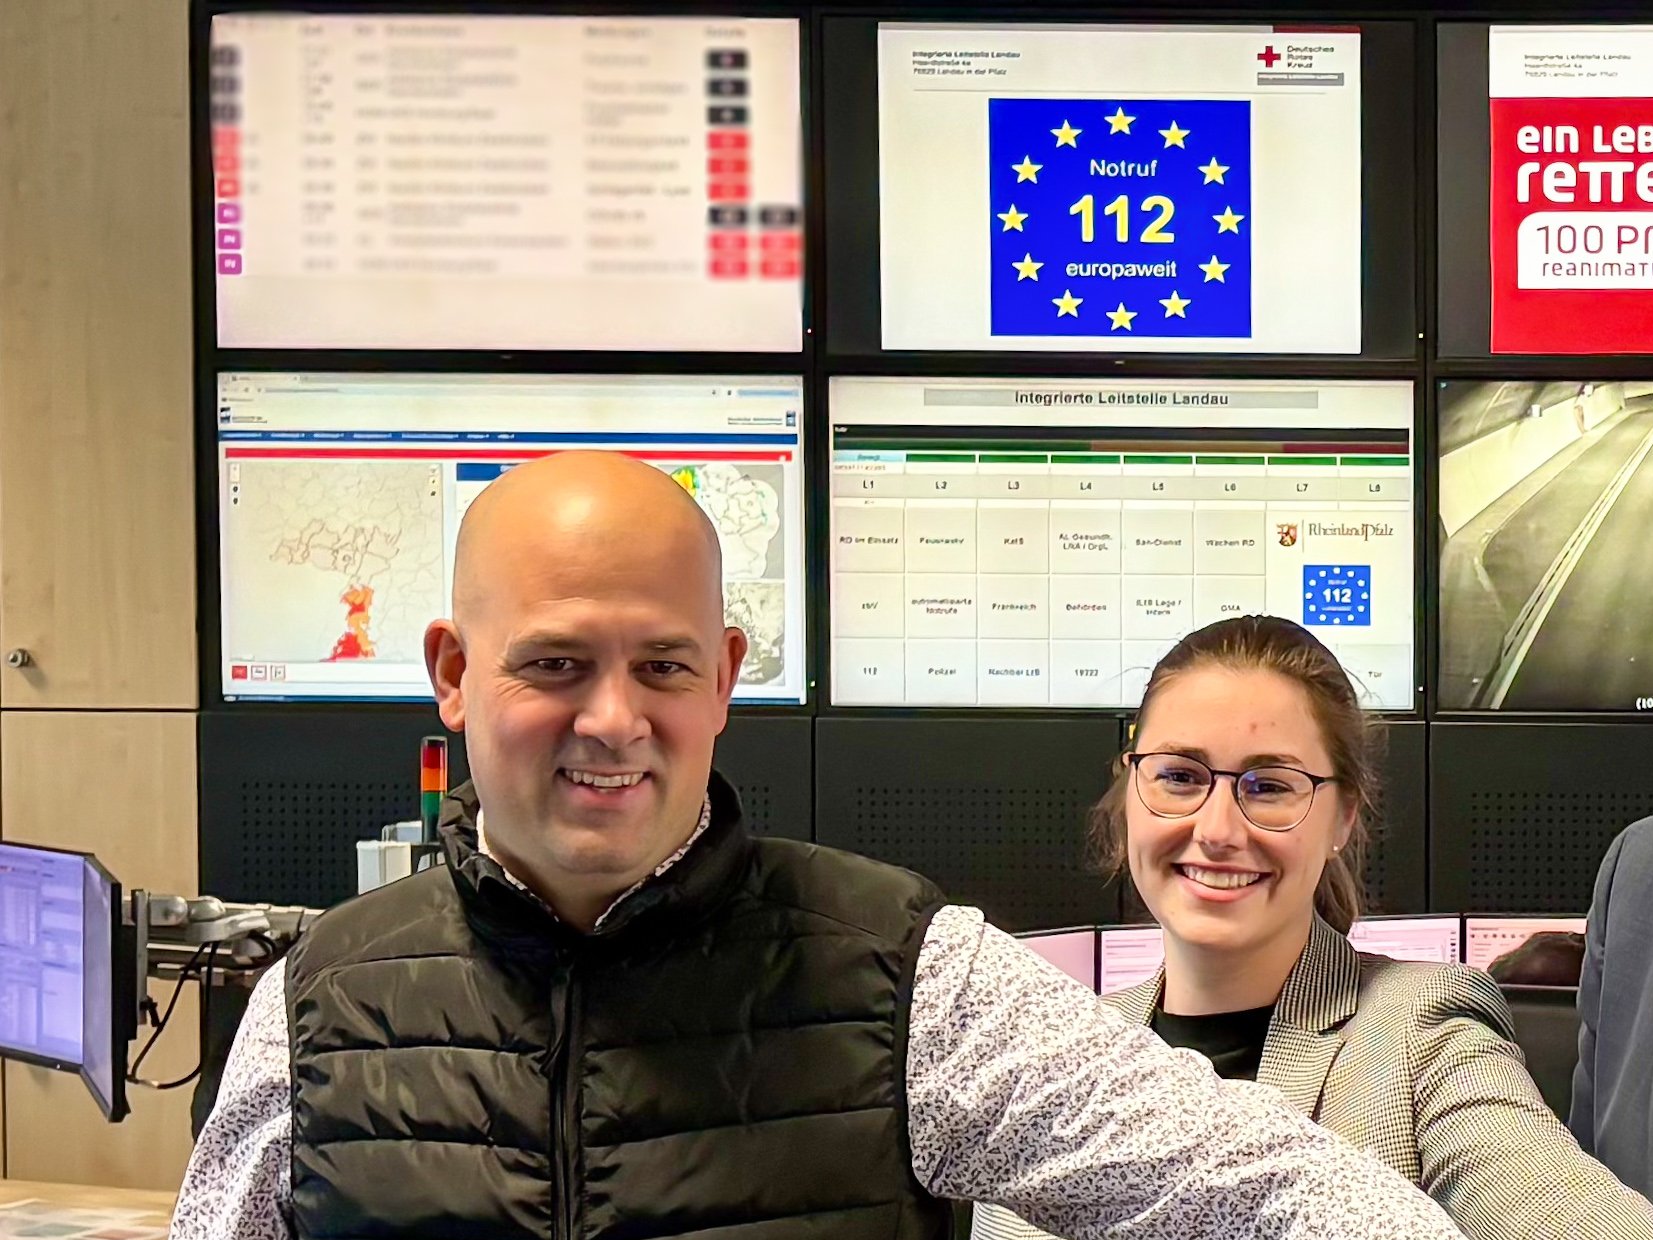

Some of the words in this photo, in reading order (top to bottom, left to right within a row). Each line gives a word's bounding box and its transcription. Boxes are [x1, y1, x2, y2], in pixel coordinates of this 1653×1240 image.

[1089, 158, 1158, 177] Notruf
[1069, 194, 1175, 243] 112
[1536, 225, 1604, 255] 100
[1065, 260, 1177, 281] europaweit
[1015, 391, 1094, 407] Integrierte
[1098, 392, 1168, 405] Leitstelle
[1172, 392, 1229, 405] Landau
[1323, 588, 1352, 603] 112
